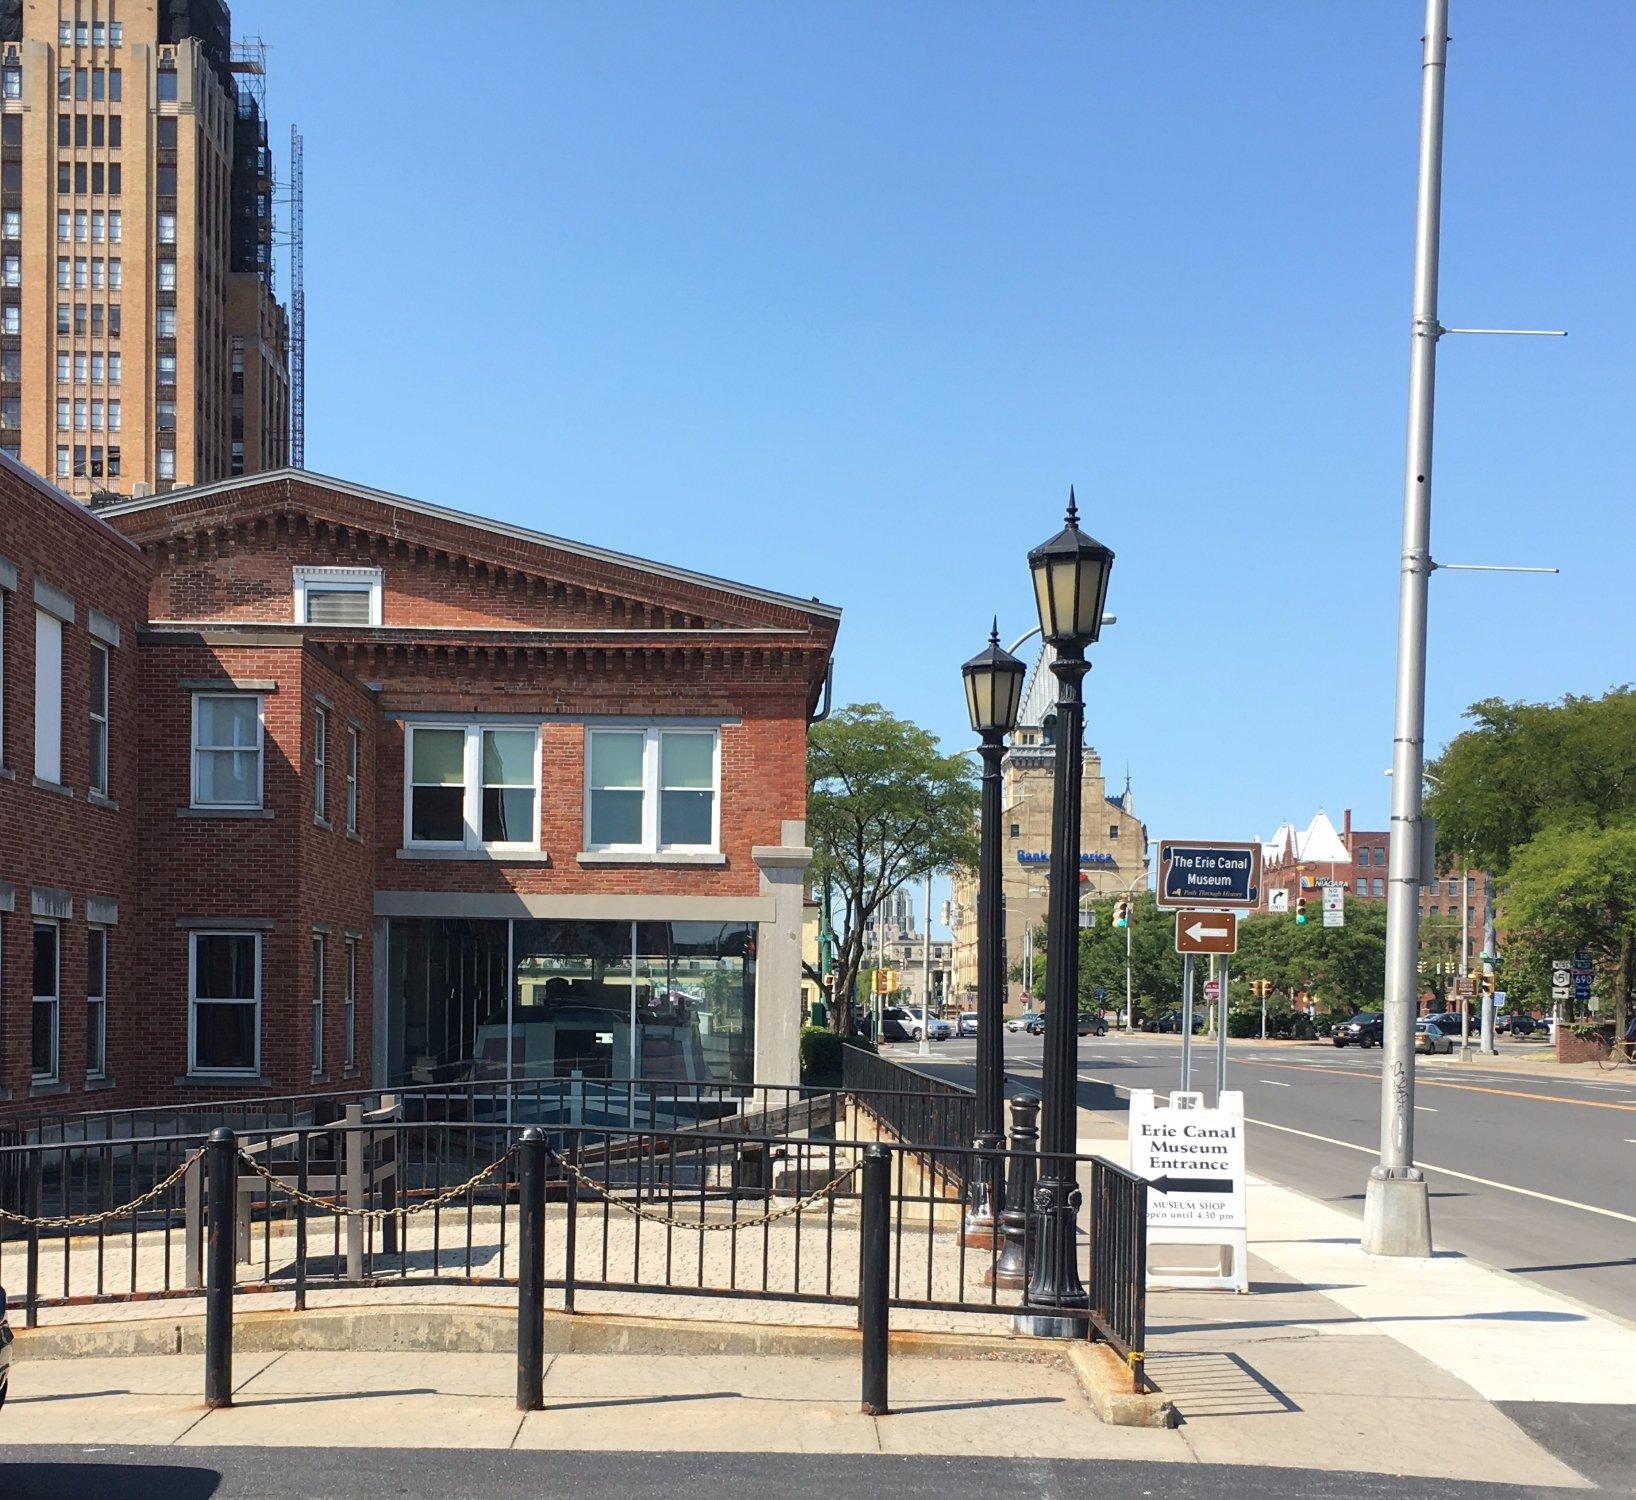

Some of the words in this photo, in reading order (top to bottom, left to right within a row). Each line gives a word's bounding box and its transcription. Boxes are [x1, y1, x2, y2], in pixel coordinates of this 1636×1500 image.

[1017, 850, 1048, 862] Bank
[1174, 856, 1192, 867] The
[1195, 856, 1216, 868] Erie
[1218, 857, 1248, 869] Canal
[1187, 873, 1232, 886] Museum
[1558, 973, 1565, 983] 5
[1575, 975, 1592, 984] 690
[1141, 1124, 1177, 1137] Erie
[1183, 1125, 1236, 1138] Canal
[1150, 1140, 1228, 1154] Museum
[1149, 1156, 1229, 1170] Entrance
[1153, 1201, 1196, 1210] MUSEUM
[1199, 1202, 1226, 1210] SHOP
[1170, 1211, 1193, 1219] until
